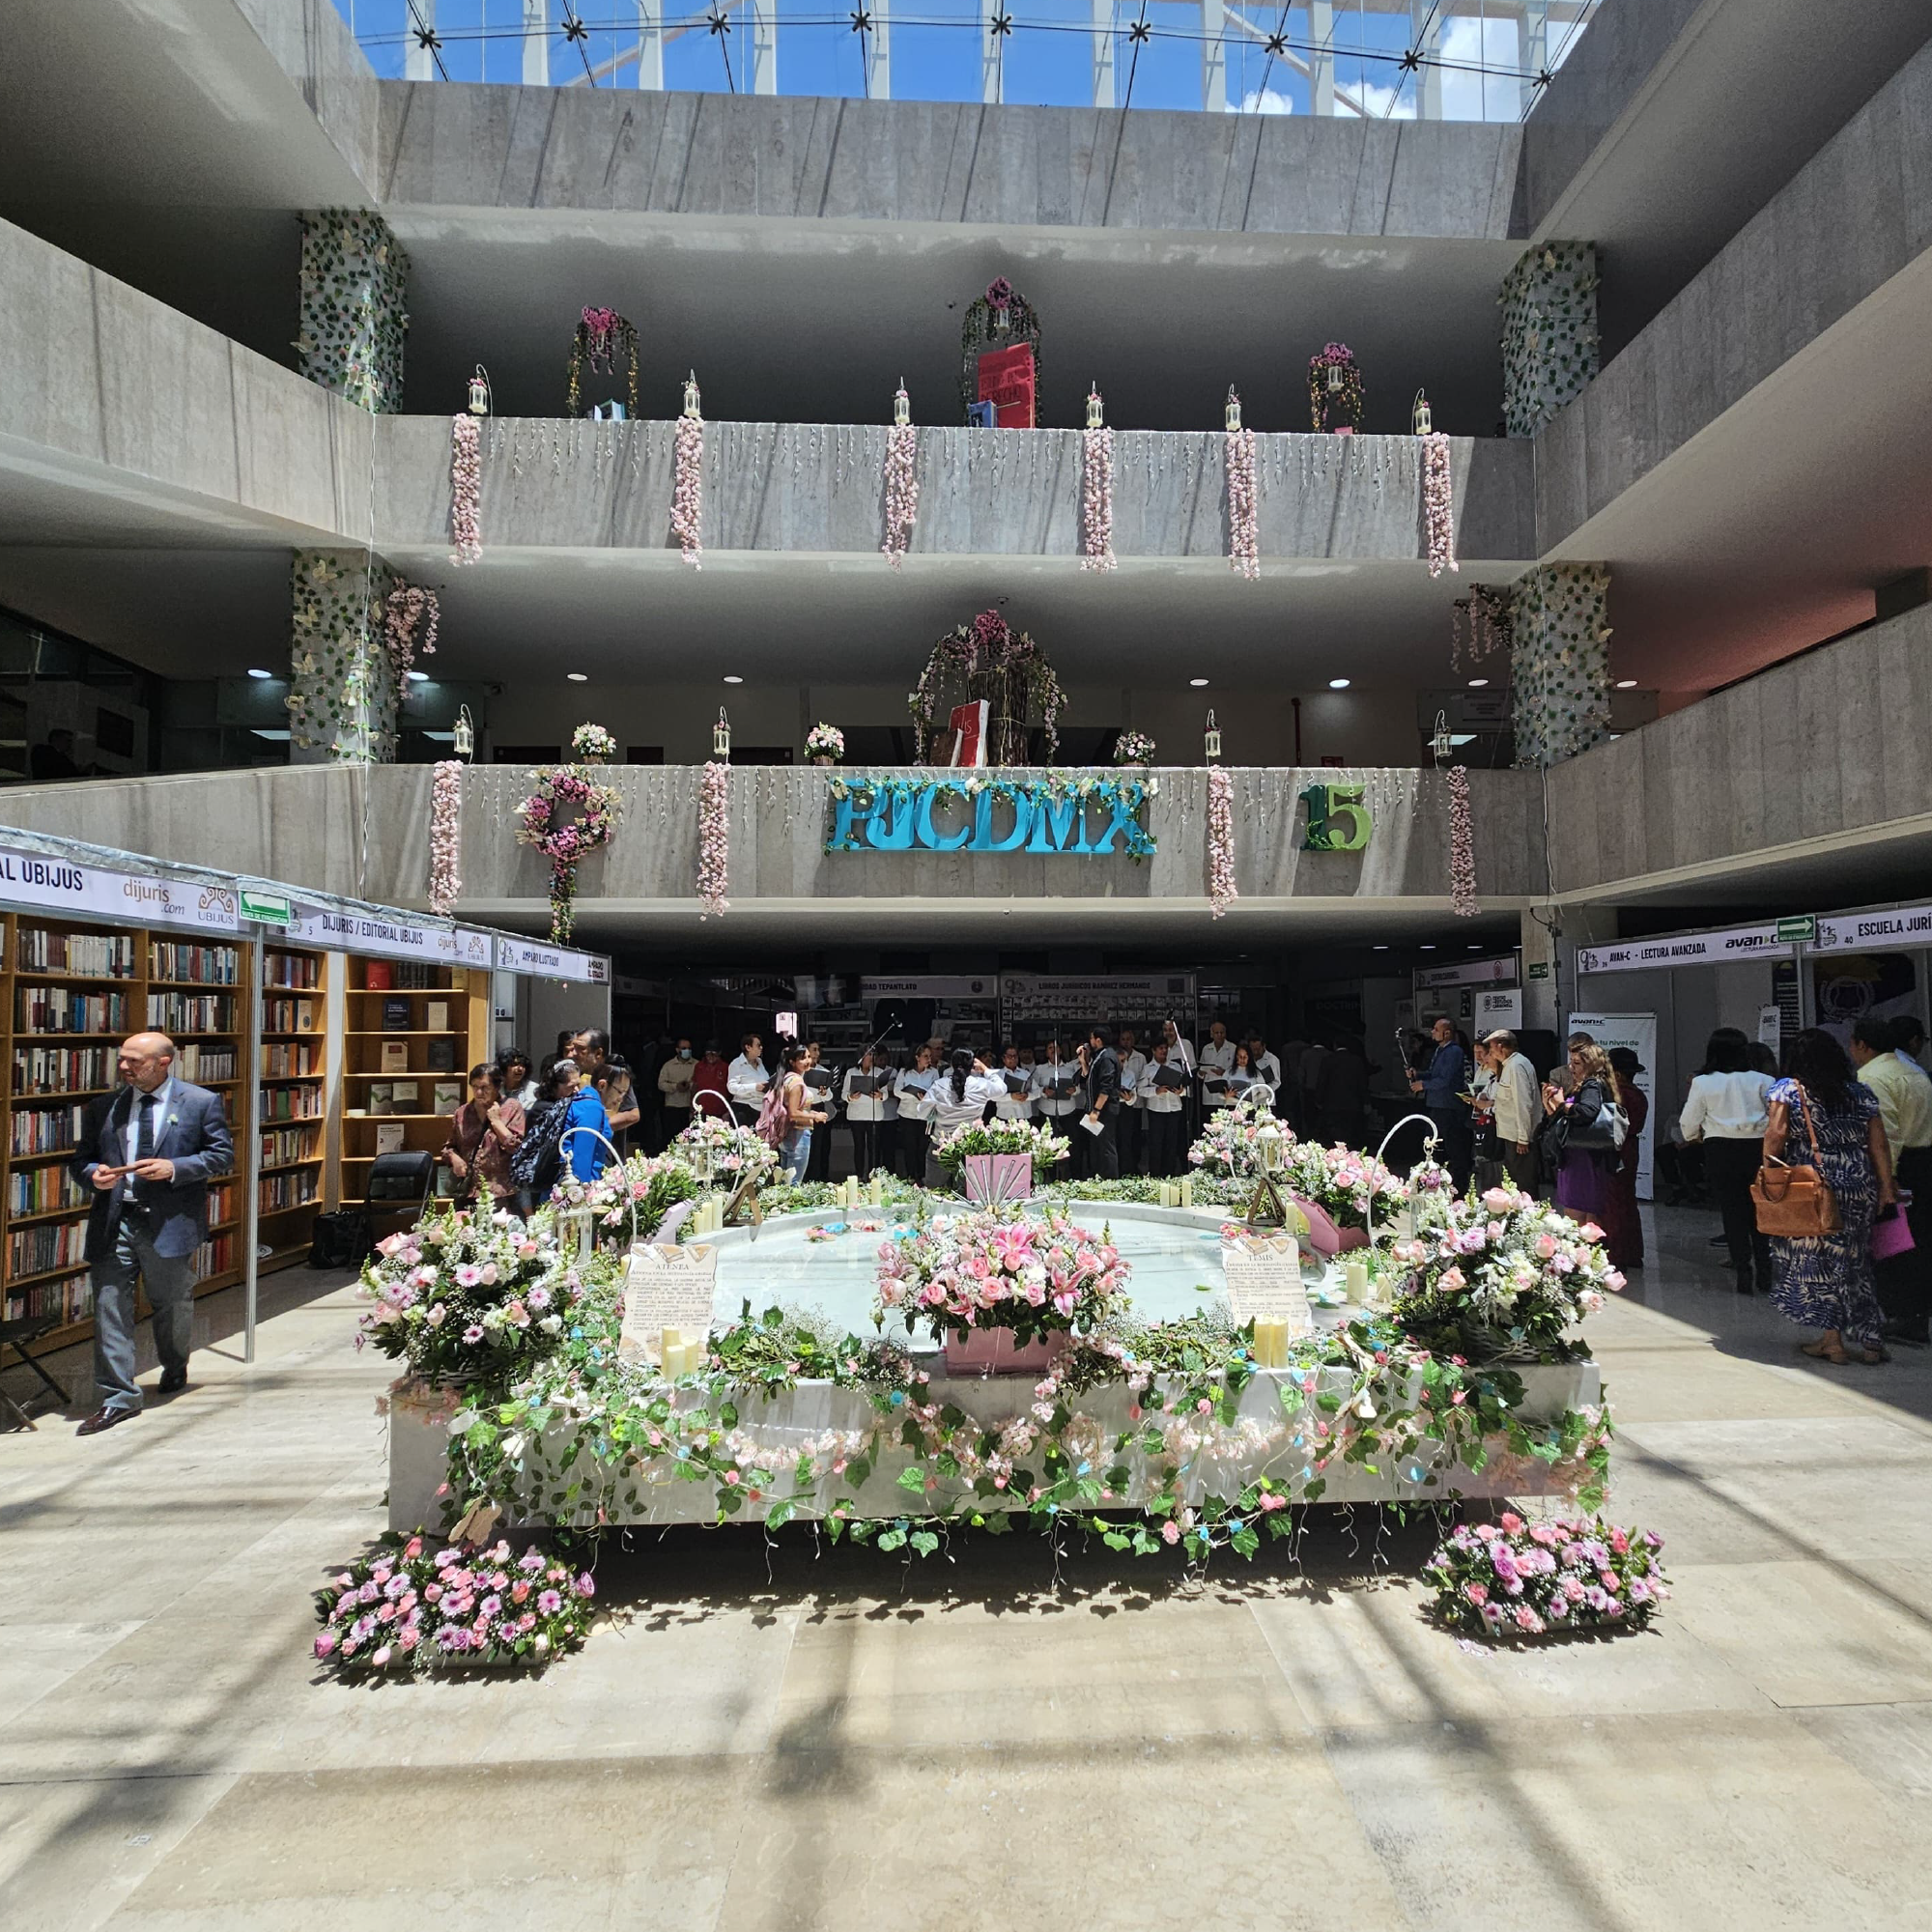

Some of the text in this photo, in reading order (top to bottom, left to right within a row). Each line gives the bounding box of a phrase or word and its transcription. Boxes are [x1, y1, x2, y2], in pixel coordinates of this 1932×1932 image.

[826, 779, 1157, 854] PJCDMX
[1297, 783, 1372, 850] 15
[22, 861, 83, 891] UBIJUS
[124, 878, 170, 903] dijuris
[161, 903, 185, 915] .com
[197, 911, 234, 924] UBIJUS
[322, 914, 354, 934] DIJURIS
[362, 922, 398, 942] EDITORIAL
[399, 928, 423, 945] UBIJUS
[1858, 912, 1932, 937] ESCUELA JURÍ
[438, 935, 458, 951] dijuris
[1844, 936, 1854, 945] 40
[522, 951, 538, 964] AMPARO
[538, 953, 559, 967] ILUSTRADO
[1609, 951, 1631, 962] AVAN-C
[1640, 947, 1670, 960] LECTURA
[1671, 942, 1707, 957] AVANZADA
